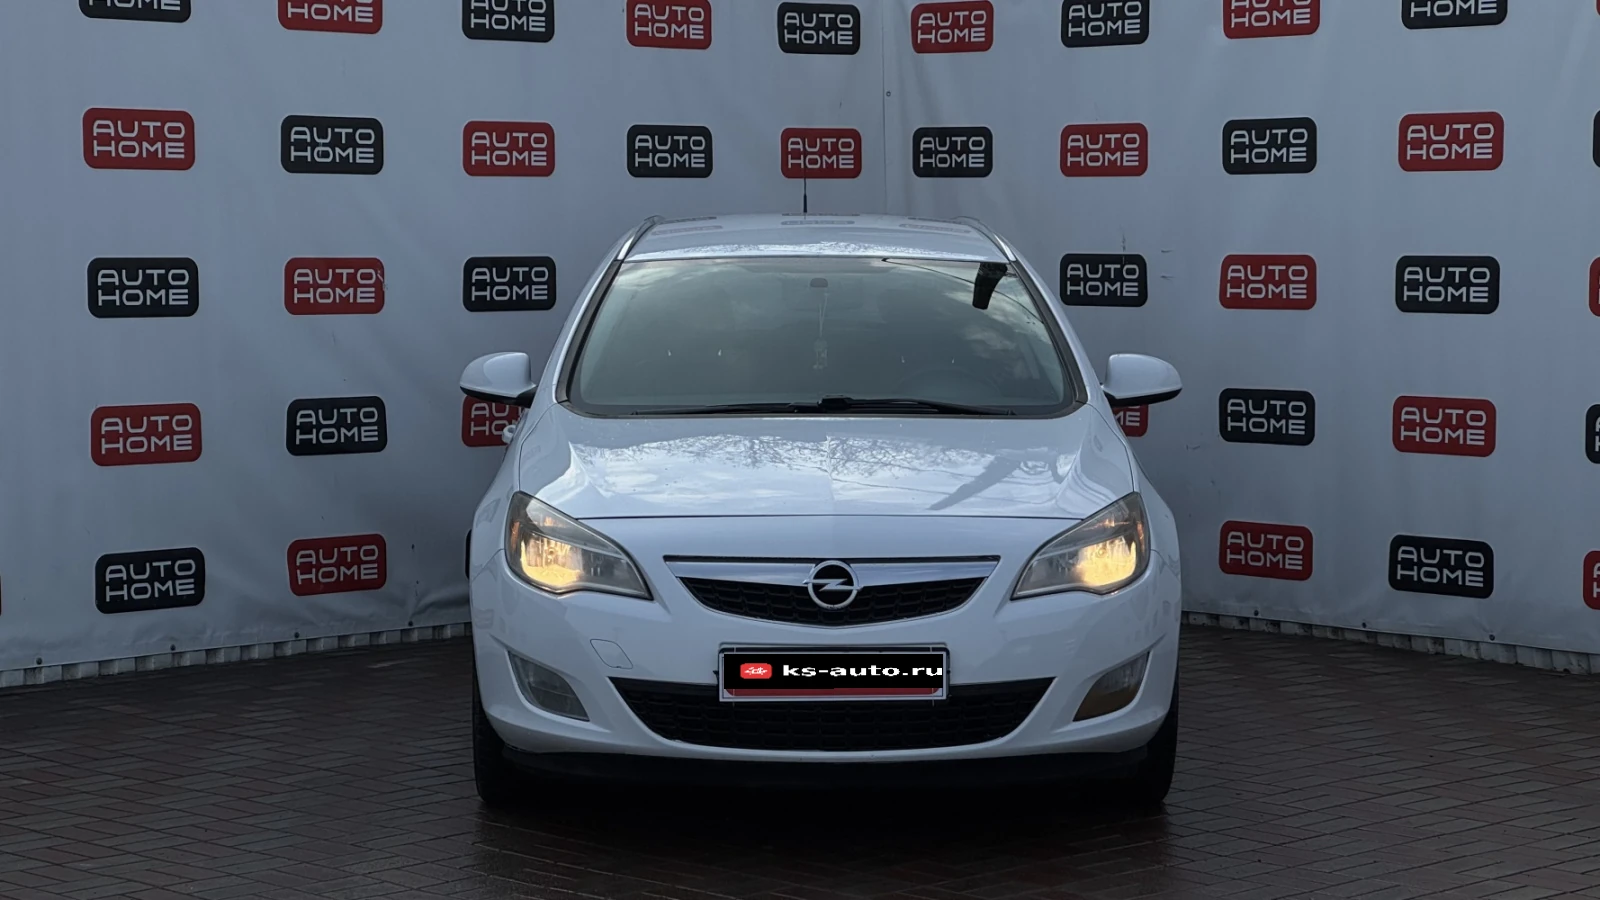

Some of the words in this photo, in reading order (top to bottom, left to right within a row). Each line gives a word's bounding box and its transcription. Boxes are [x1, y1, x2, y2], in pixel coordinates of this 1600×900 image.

[288, 2, 373, 23] HOME
[634, 4, 704, 22] AUTO
[1069, 1, 1142, 20] AUTO
[1410, 0, 1497, 18] HOME
[471, 13, 546, 32] HOME
[784, 12, 853, 28] AUTO
[918, 10, 987, 27] AUTO
[1231, 8, 1311, 28] HOME
[635, 21, 704, 39] HOME
[917, 27, 985, 44] HOME
[1068, 19, 1140, 37] HOME
[784, 29, 853, 45] HOME
[93, 120, 185, 139] AUTO
[291, 127, 375, 145] AUTO
[1231, 128, 1308, 145] AUTO
[1407, 123, 1494, 141] AUTO
[472, 132, 547, 148] AUTO
[635, 135, 705, 150] AUTO
[788, 138, 854, 152] AUTO
[920, 136, 985, 151] AUTO
[1067, 133, 1140, 149] AUTO
[93, 140, 185, 159] HOME
[291, 146, 374, 163] HOME
[471, 150, 547, 166] HOME
[1231, 147, 1307, 164] HOME
[1407, 143, 1492, 160] HOME
[635, 152, 705, 168] HOME
[788, 154, 854, 169] HOME
[920, 153, 985, 167] HOME
[1067, 151, 1139, 166] HOME
[98, 269, 189, 286] AUTO
[294, 268, 376, 284] AUTO
[472, 267, 549, 283] AUTO
[1067, 264, 1139, 279] AUTO
[1227, 265, 1308, 280] AUTO
[1404, 267, 1490, 283] AUTO
[294, 287, 375, 303] HOME
[471, 285, 548, 301] HOME
[1067, 281, 1138, 296] HOME
[1226, 283, 1307, 299] HOME
[1403, 285, 1489, 303] HOME
[98, 289, 188, 306] HOME
[1227, 399, 1306, 416] AUTO
[101, 415, 192, 434] AUTO
[296, 407, 378, 426] AUTO
[1401, 407, 1486, 426] AUTO
[1227, 416, 1305, 435] HOME
[296, 426, 378, 445] HOME
[1400, 425, 1485, 445] HOME
[101, 434, 192, 454] HOME
[1227, 531, 1304, 552] AUTO
[296, 545, 378, 566] AUTO
[1226, 549, 1303, 570] HOME
[1398, 546, 1484, 568] AUTO
[105, 559, 196, 582] AUTO
[297, 563, 378, 585] HOME
[1397, 564, 1483, 587] HOME
[106, 578, 195, 602] HOME
